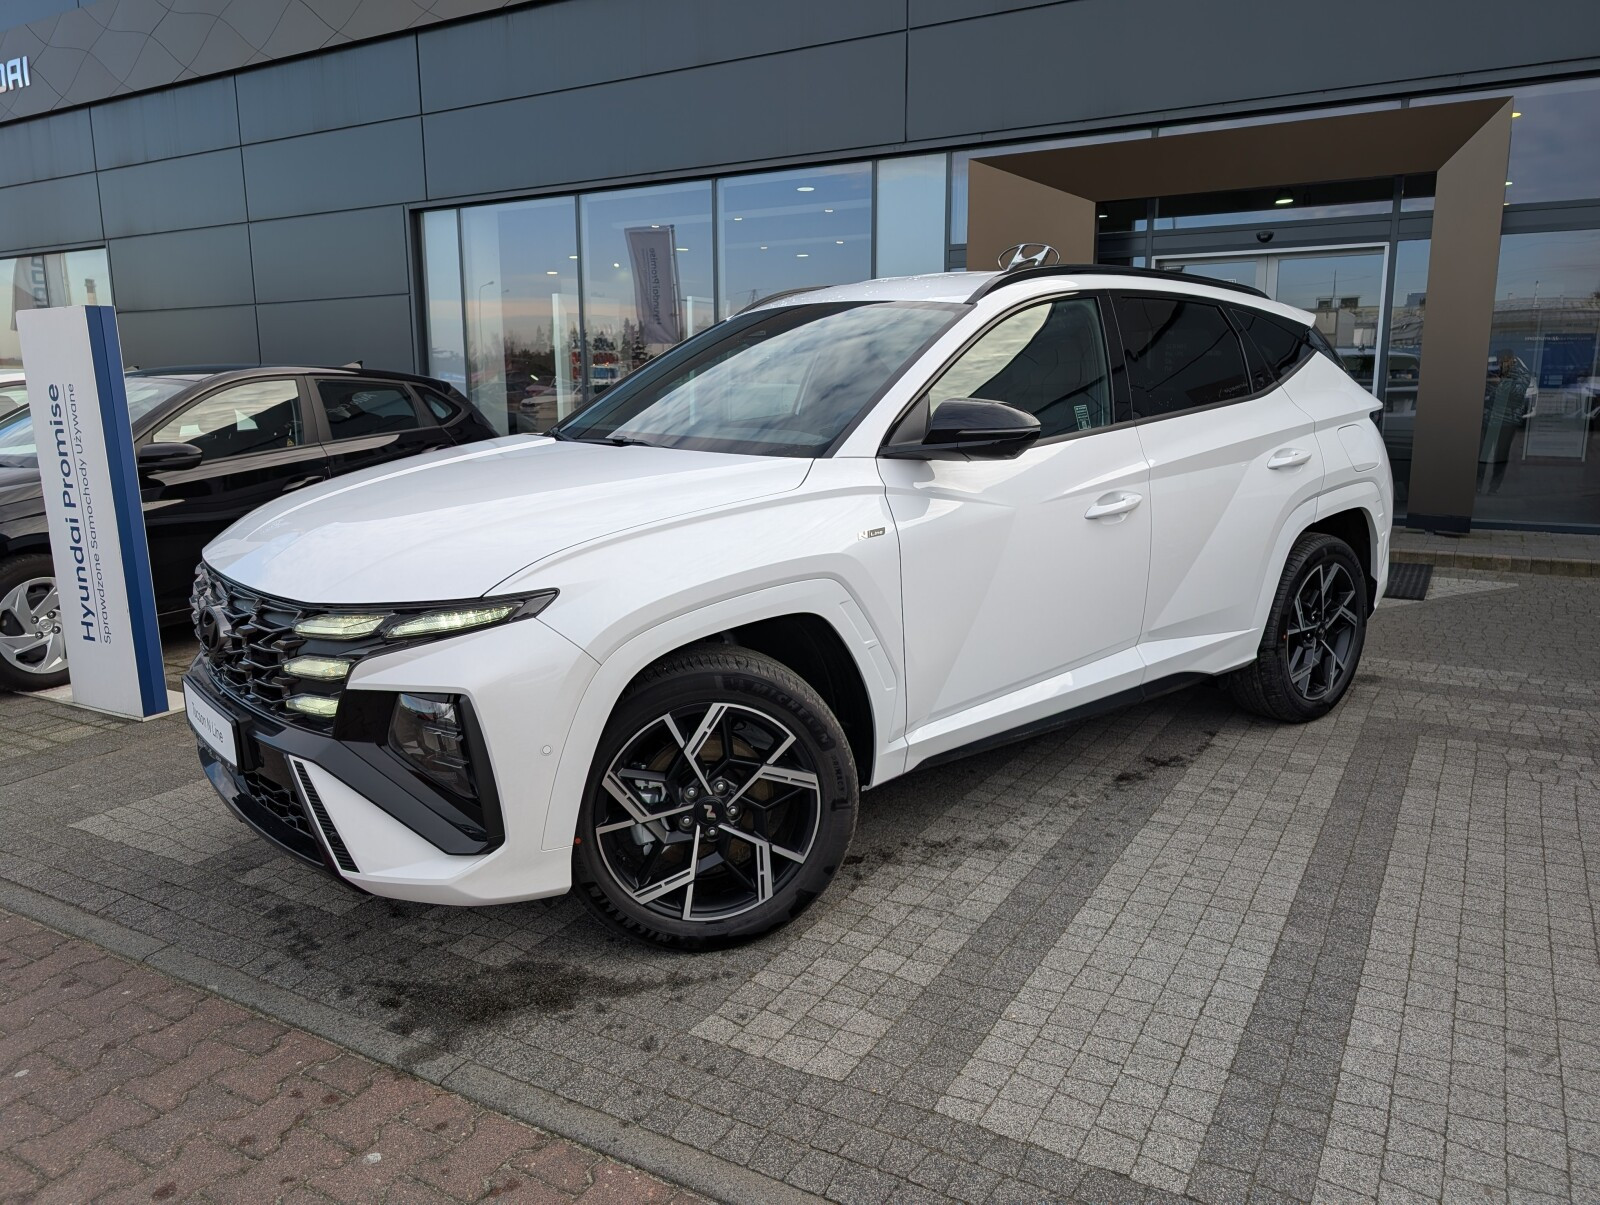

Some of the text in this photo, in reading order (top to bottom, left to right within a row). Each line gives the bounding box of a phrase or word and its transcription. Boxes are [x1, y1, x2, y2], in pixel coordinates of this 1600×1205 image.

[48, 383, 96, 642] Hyundai Promise
[68, 383, 112, 644] Sprawdzone Samochody Używane
[750, 682, 832, 744] MICHELIN
